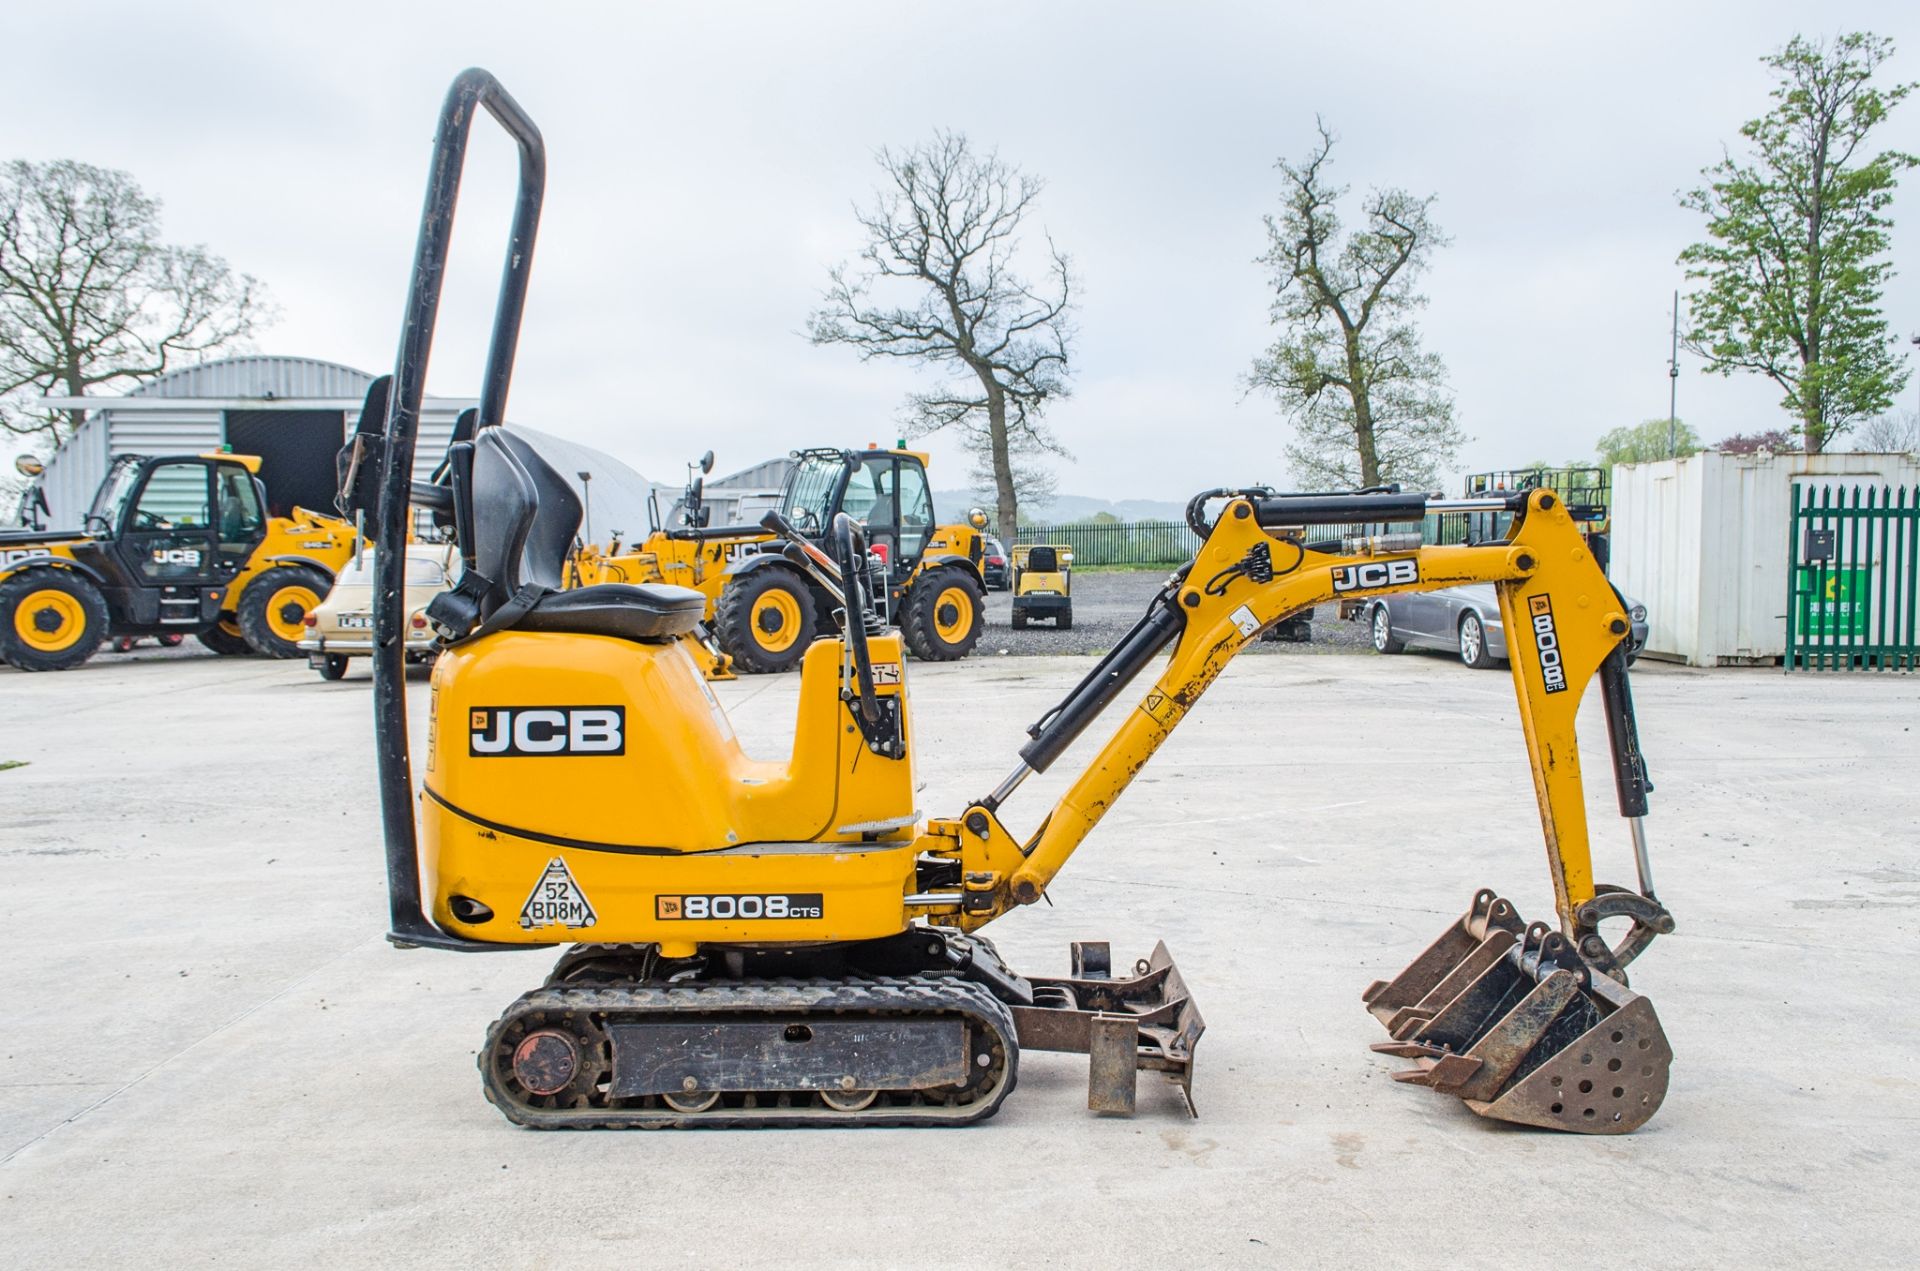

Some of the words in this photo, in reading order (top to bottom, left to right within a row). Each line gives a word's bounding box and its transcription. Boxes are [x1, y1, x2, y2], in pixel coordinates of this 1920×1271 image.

[153, 550, 200, 563] JCB
[1334, 560, 1418, 591] JCB
[472, 710, 622, 753] JCB
[545, 882, 569, 900] 52
